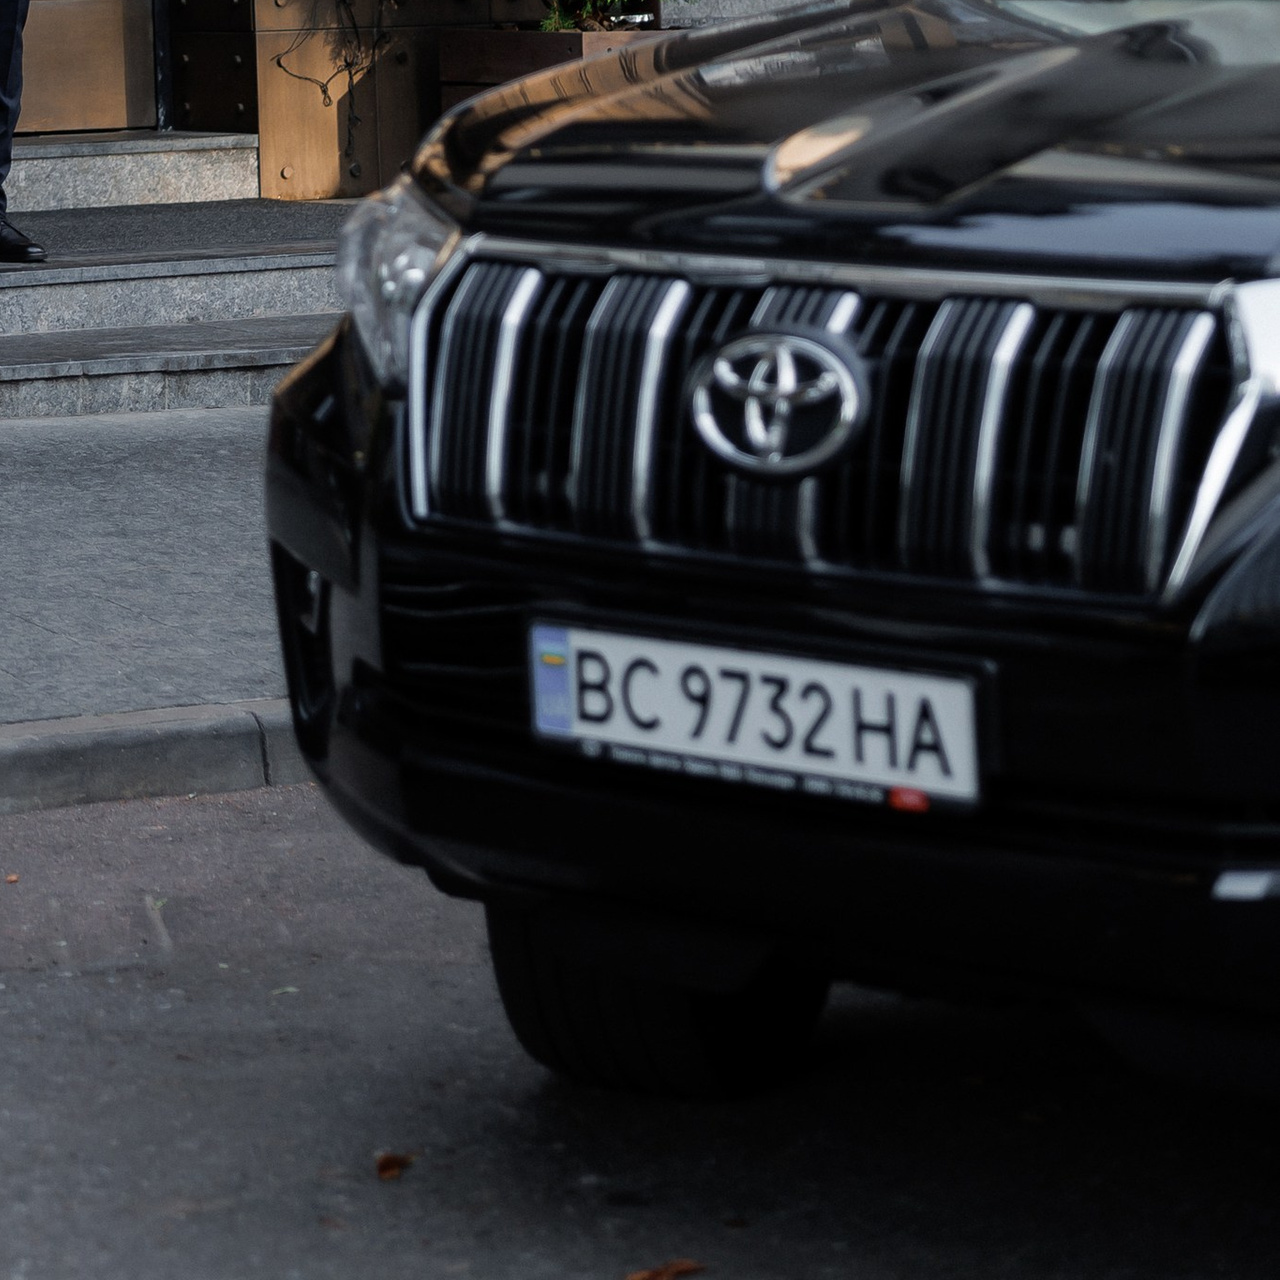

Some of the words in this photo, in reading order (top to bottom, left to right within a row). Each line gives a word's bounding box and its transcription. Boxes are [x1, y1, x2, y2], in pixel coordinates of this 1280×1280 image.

[575, 648, 661, 732] BC
[680, 665, 835, 761] 9732
[852, 686, 952, 777] HA
